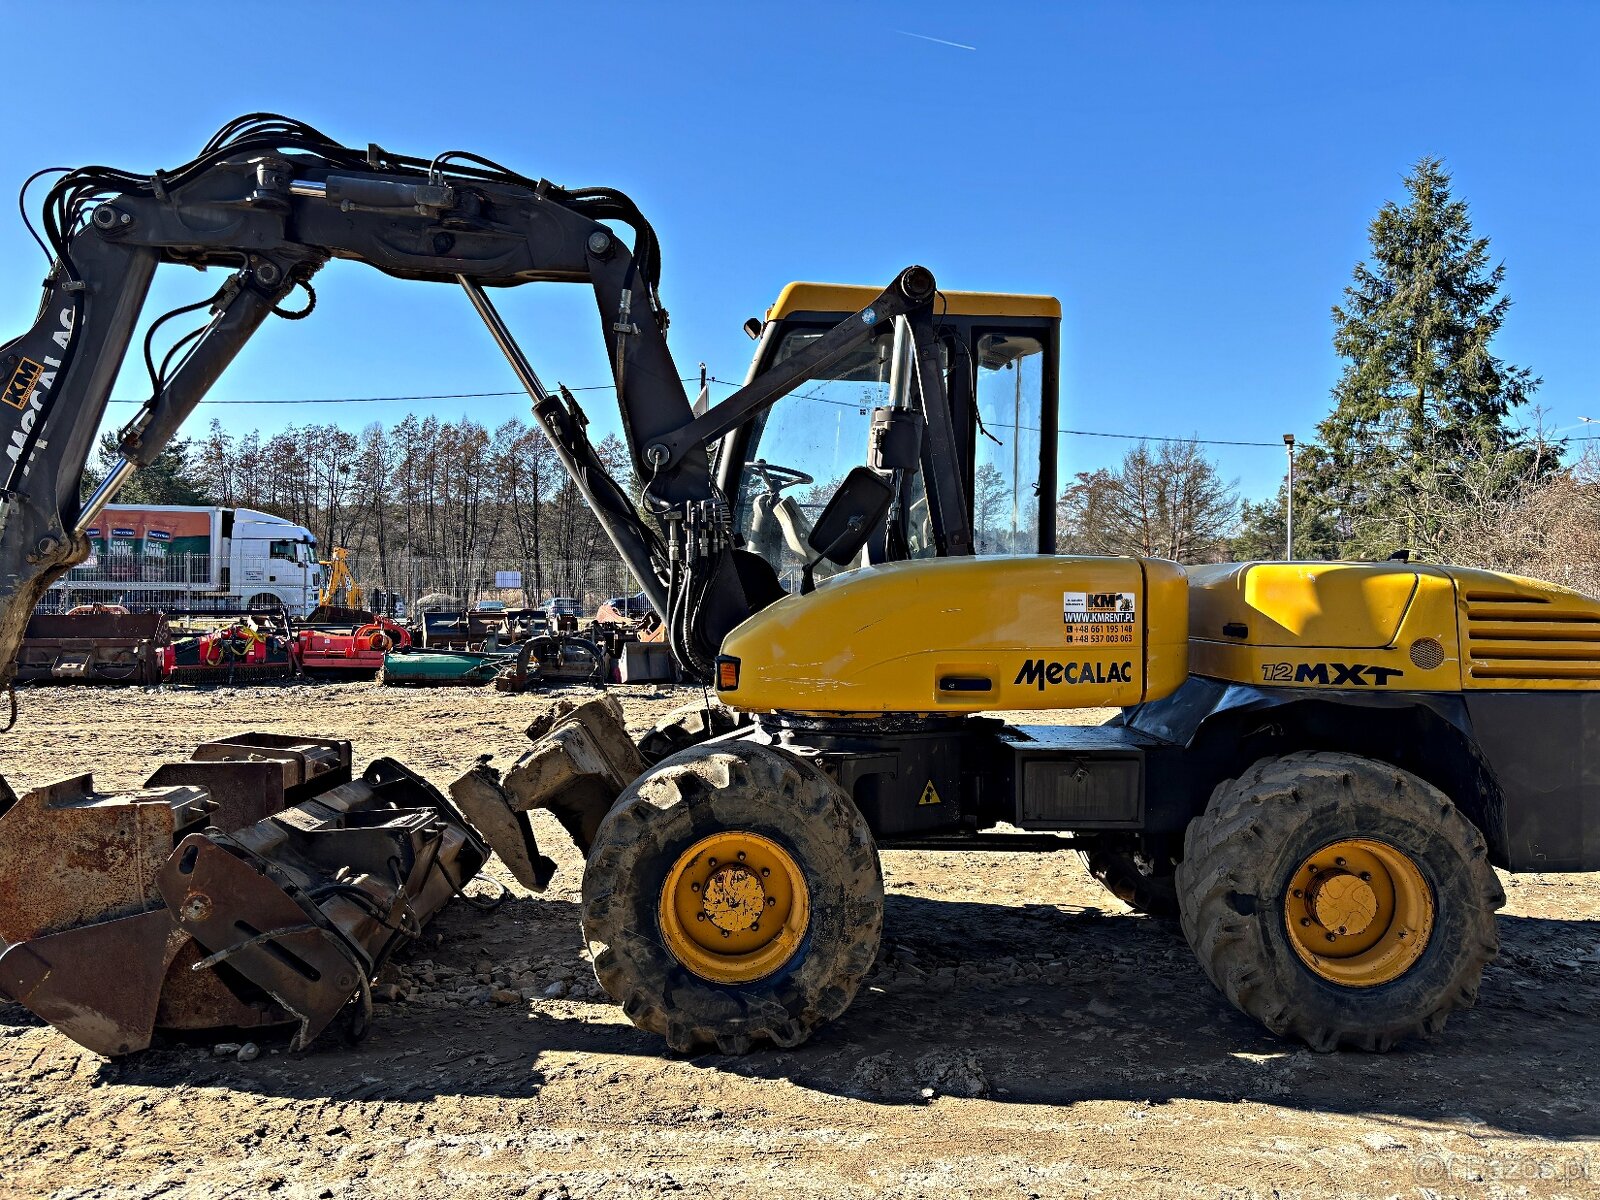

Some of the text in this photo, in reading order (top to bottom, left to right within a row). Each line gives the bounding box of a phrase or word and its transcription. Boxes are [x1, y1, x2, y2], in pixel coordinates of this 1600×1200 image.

[4, 359, 39, 404] KM
[1087, 594, 1116, 607] KM
[1064, 612, 1134, 623] WWW.KMRENT.PL
[1074, 625, 1133, 633] +48 661 195 148
[1074, 635, 1133, 643] +48 537 003 063
